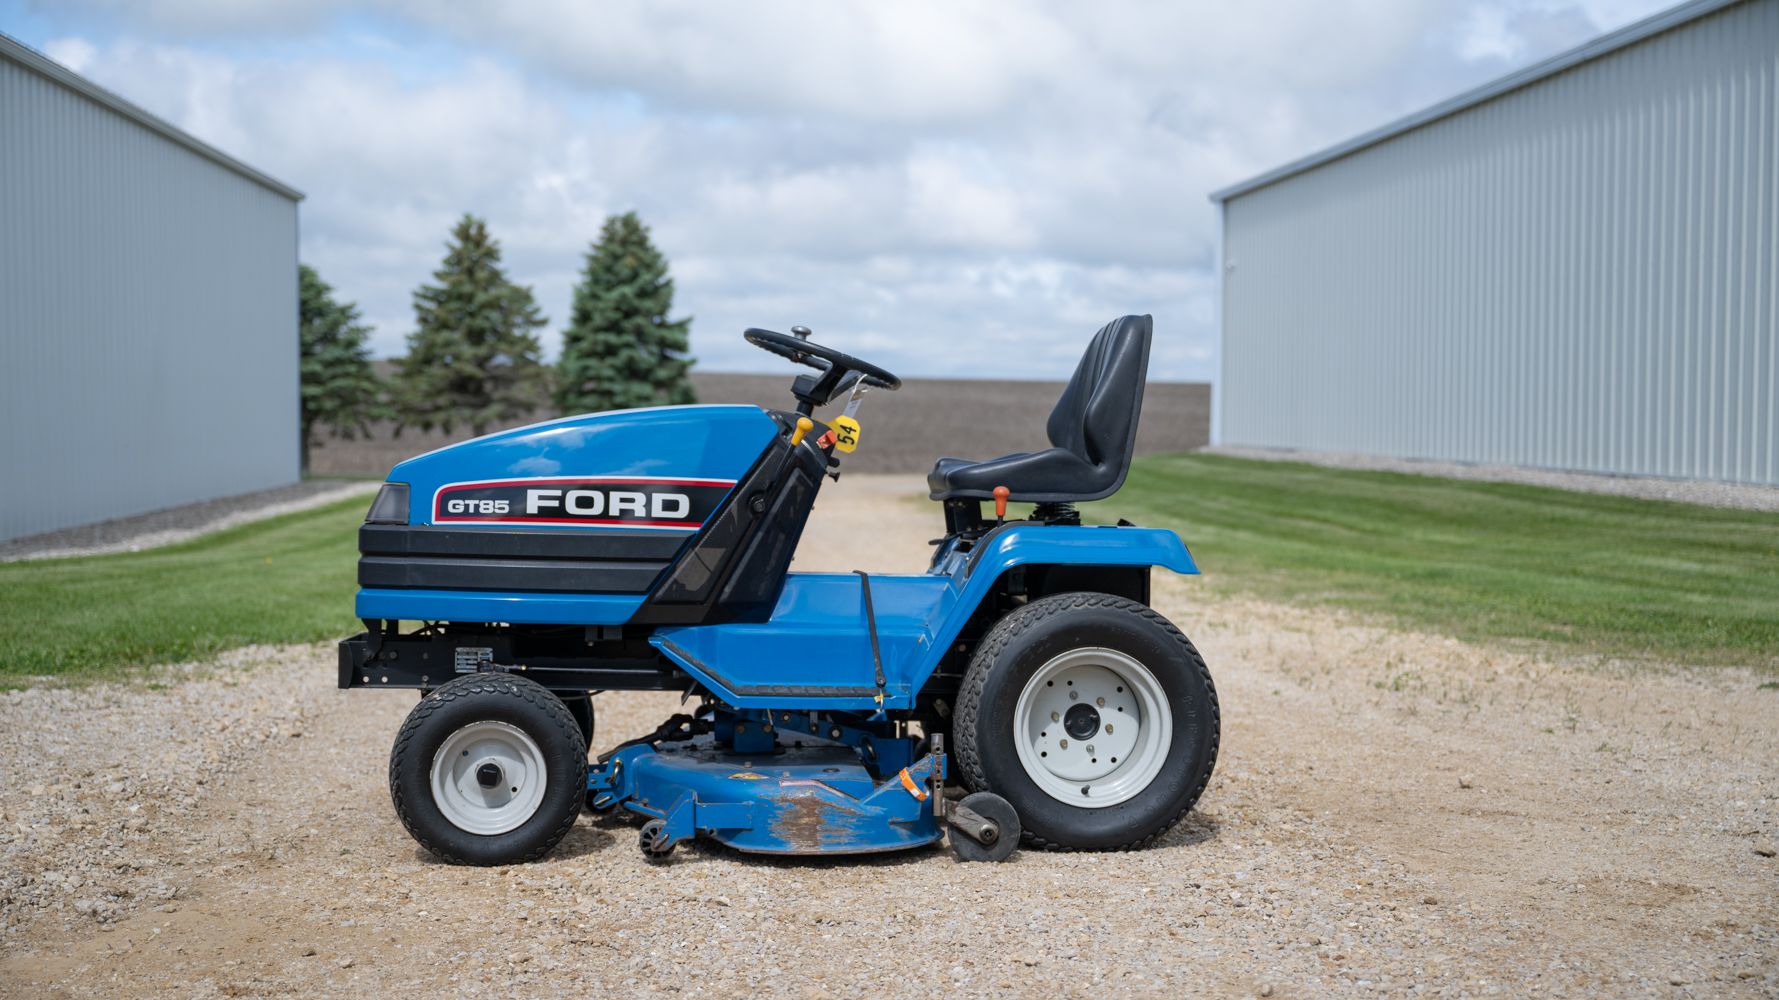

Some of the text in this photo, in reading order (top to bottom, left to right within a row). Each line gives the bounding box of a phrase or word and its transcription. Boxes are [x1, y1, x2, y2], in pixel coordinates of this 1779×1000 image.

[838, 425, 857, 445] 54
[447, 490, 690, 519] GT85 FORD
